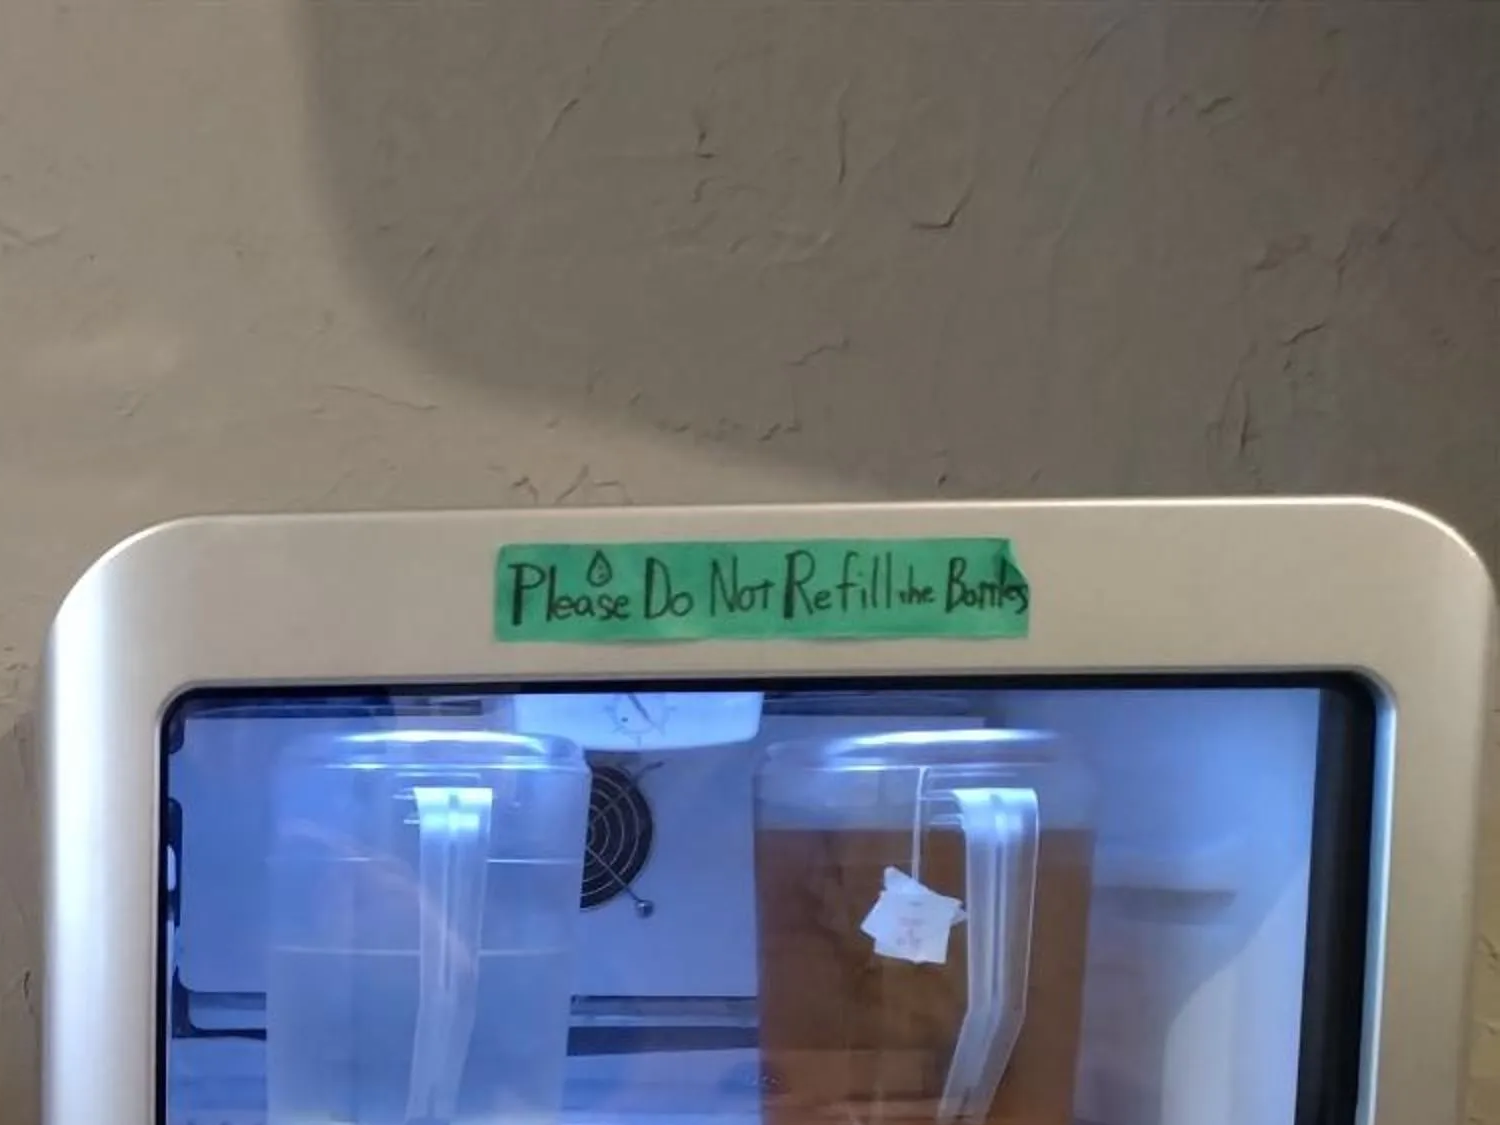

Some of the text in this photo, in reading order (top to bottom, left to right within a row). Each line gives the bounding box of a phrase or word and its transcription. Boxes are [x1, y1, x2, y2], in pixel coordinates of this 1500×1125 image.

[508, 562, 632, 626] Please
[644, 556, 694, 619] Do
[710, 554, 776, 617] Not
[784, 549, 892, 619] Refill
